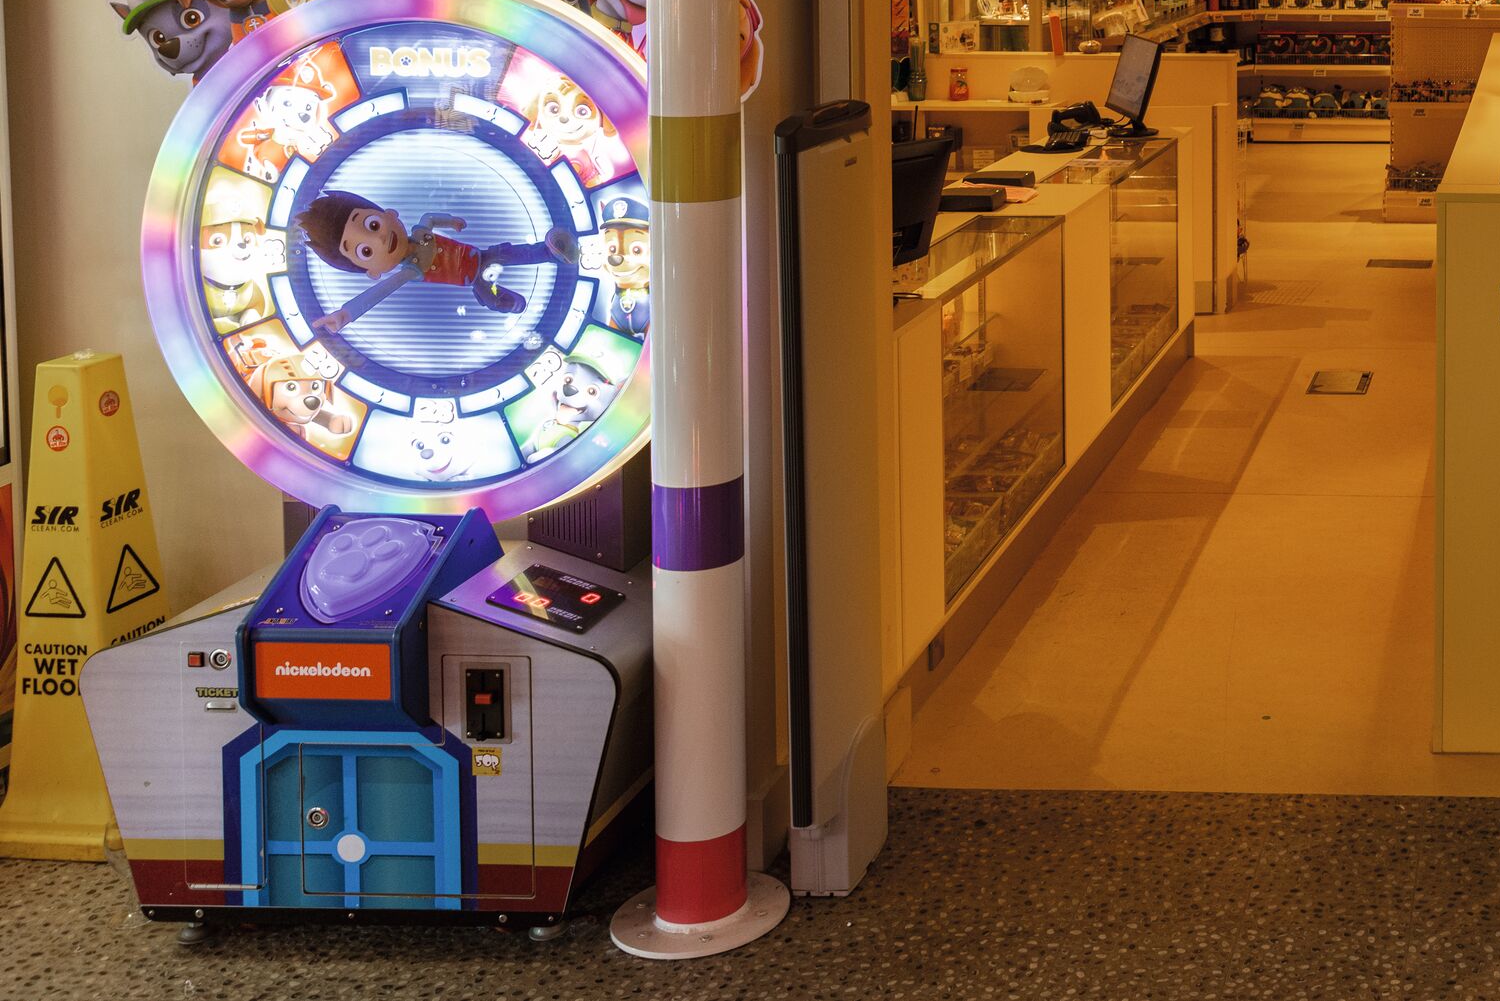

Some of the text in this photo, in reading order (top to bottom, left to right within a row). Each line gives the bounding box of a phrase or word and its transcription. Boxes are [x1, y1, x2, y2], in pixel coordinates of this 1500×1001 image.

[369, 47, 491, 78] BONUS
[100, 488, 141, 522] SIR
[31, 505, 79, 525] SIR
[24, 643, 87, 656] CAUTION
[34, 658, 79, 676] WET
[275, 662, 371, 677] nickelodeon
[22, 678, 81, 696] FLOO
